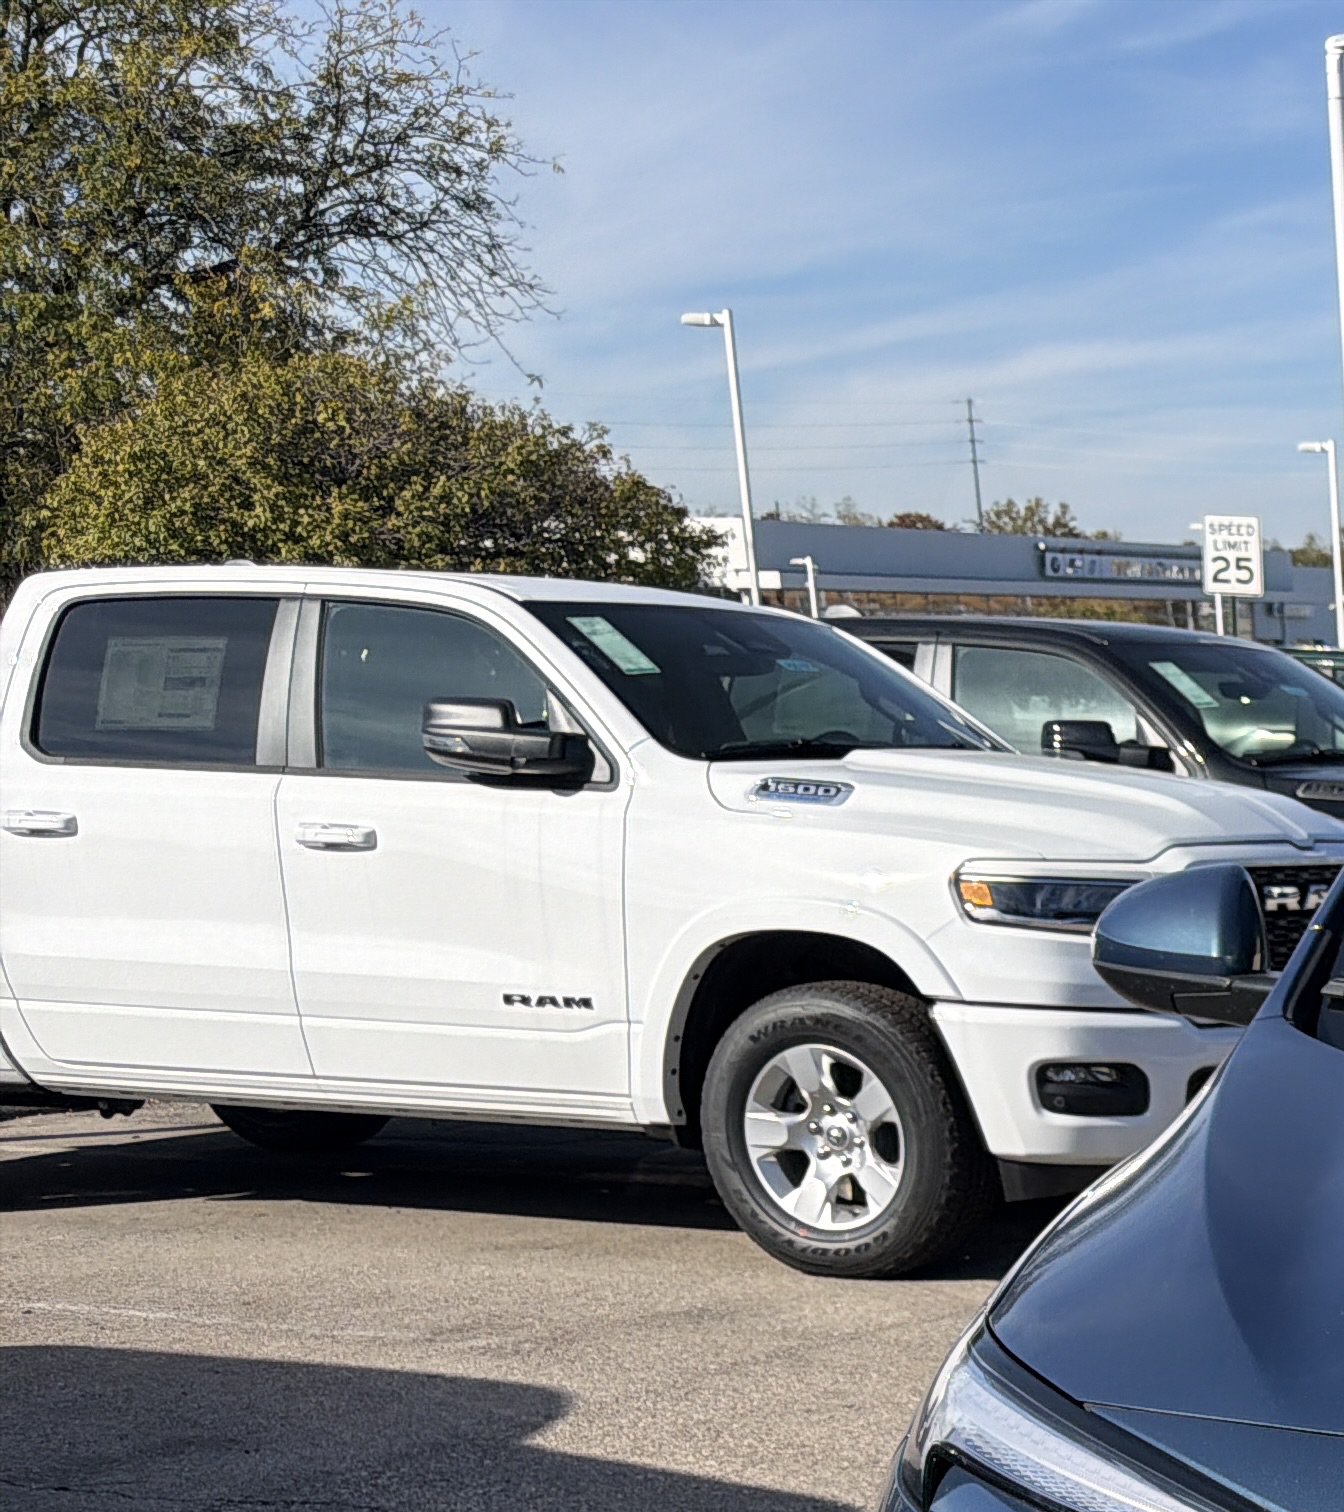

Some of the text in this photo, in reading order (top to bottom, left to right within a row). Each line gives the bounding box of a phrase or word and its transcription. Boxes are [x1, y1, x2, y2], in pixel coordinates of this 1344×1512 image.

[1208, 522, 1256, 537] SPEED
[1212, 539, 1250, 552] LIMIT
[1211, 556, 1254, 585] 25
[767, 779, 838, 796] 1500
[1263, 884, 1330, 911] RA
[502, 993, 595, 1011] RAM
